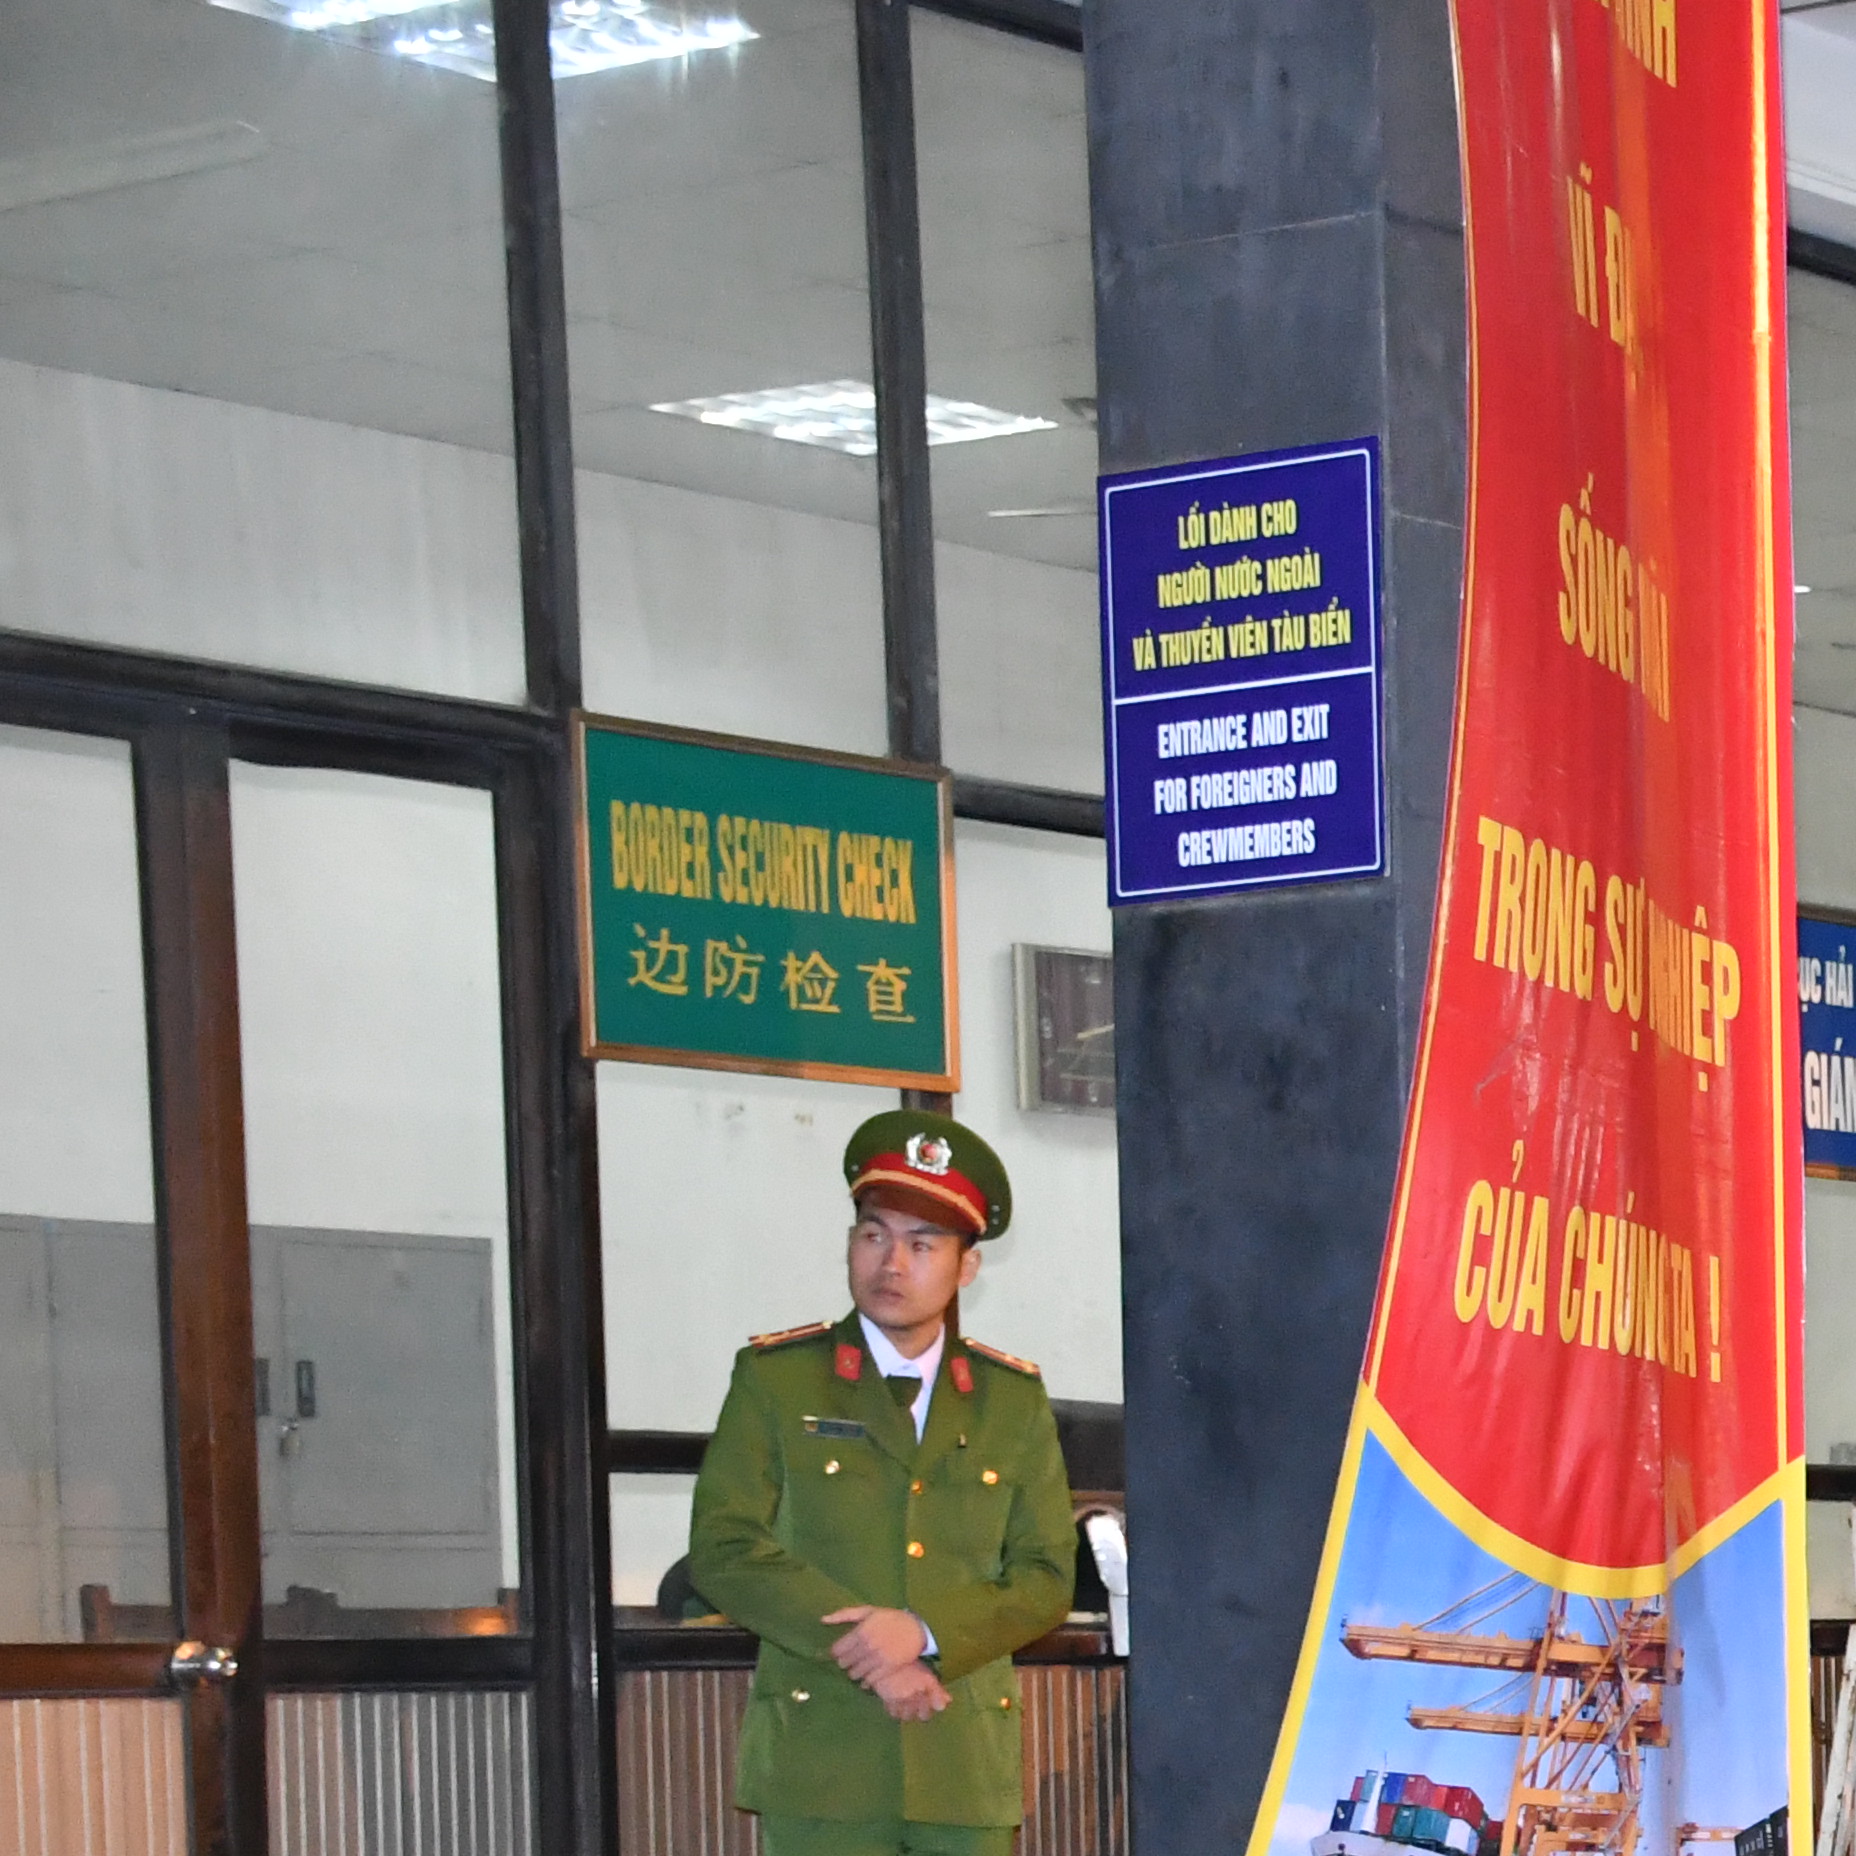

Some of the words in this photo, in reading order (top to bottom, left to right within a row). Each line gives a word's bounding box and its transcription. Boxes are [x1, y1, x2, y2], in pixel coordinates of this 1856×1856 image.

[1209, 501, 1258, 546] DÀNH
[1261, 499, 1298, 538] CHO
[1157, 560, 1211, 608] NGƯỜI
[1214, 555, 1263, 600] NƯỚC
[1266, 546, 1321, 594] NGOÀI
[1558, 471, 1635, 683] SỐNG
[1132, 629, 1157, 671] VÀ
[1228, 614, 1269, 658] VIÊN
[1271, 609, 1306, 653] TÀU
[1157, 714, 1248, 759] ENTRANCE
[1251, 709, 1288, 748] AND
[1291, 703, 1330, 742] EXIT
[1154, 777, 1187, 815] FOR
[1190, 763, 1297, 810] FOREIGNERS
[1300, 759, 1338, 798] AND
[610, 799, 712, 900] BORDER
[716, 813, 830, 914] SECURITY
[837, 831, 917, 924] CHECK
[1178, 818, 1316, 867] CREWMEMBERS
[1473, 815, 1597, 1001] TRONG
[1604, 874, 1646, 1052] SỰ
[628, 922, 917, 1024] 边防检查
[1797, 955, 1822, 1013] ỤC
[1825, 945, 1854, 1008] HẢI
[1454, 1139, 1550, 1337] CỦA
[1669, 1242, 1698, 1379] TA
